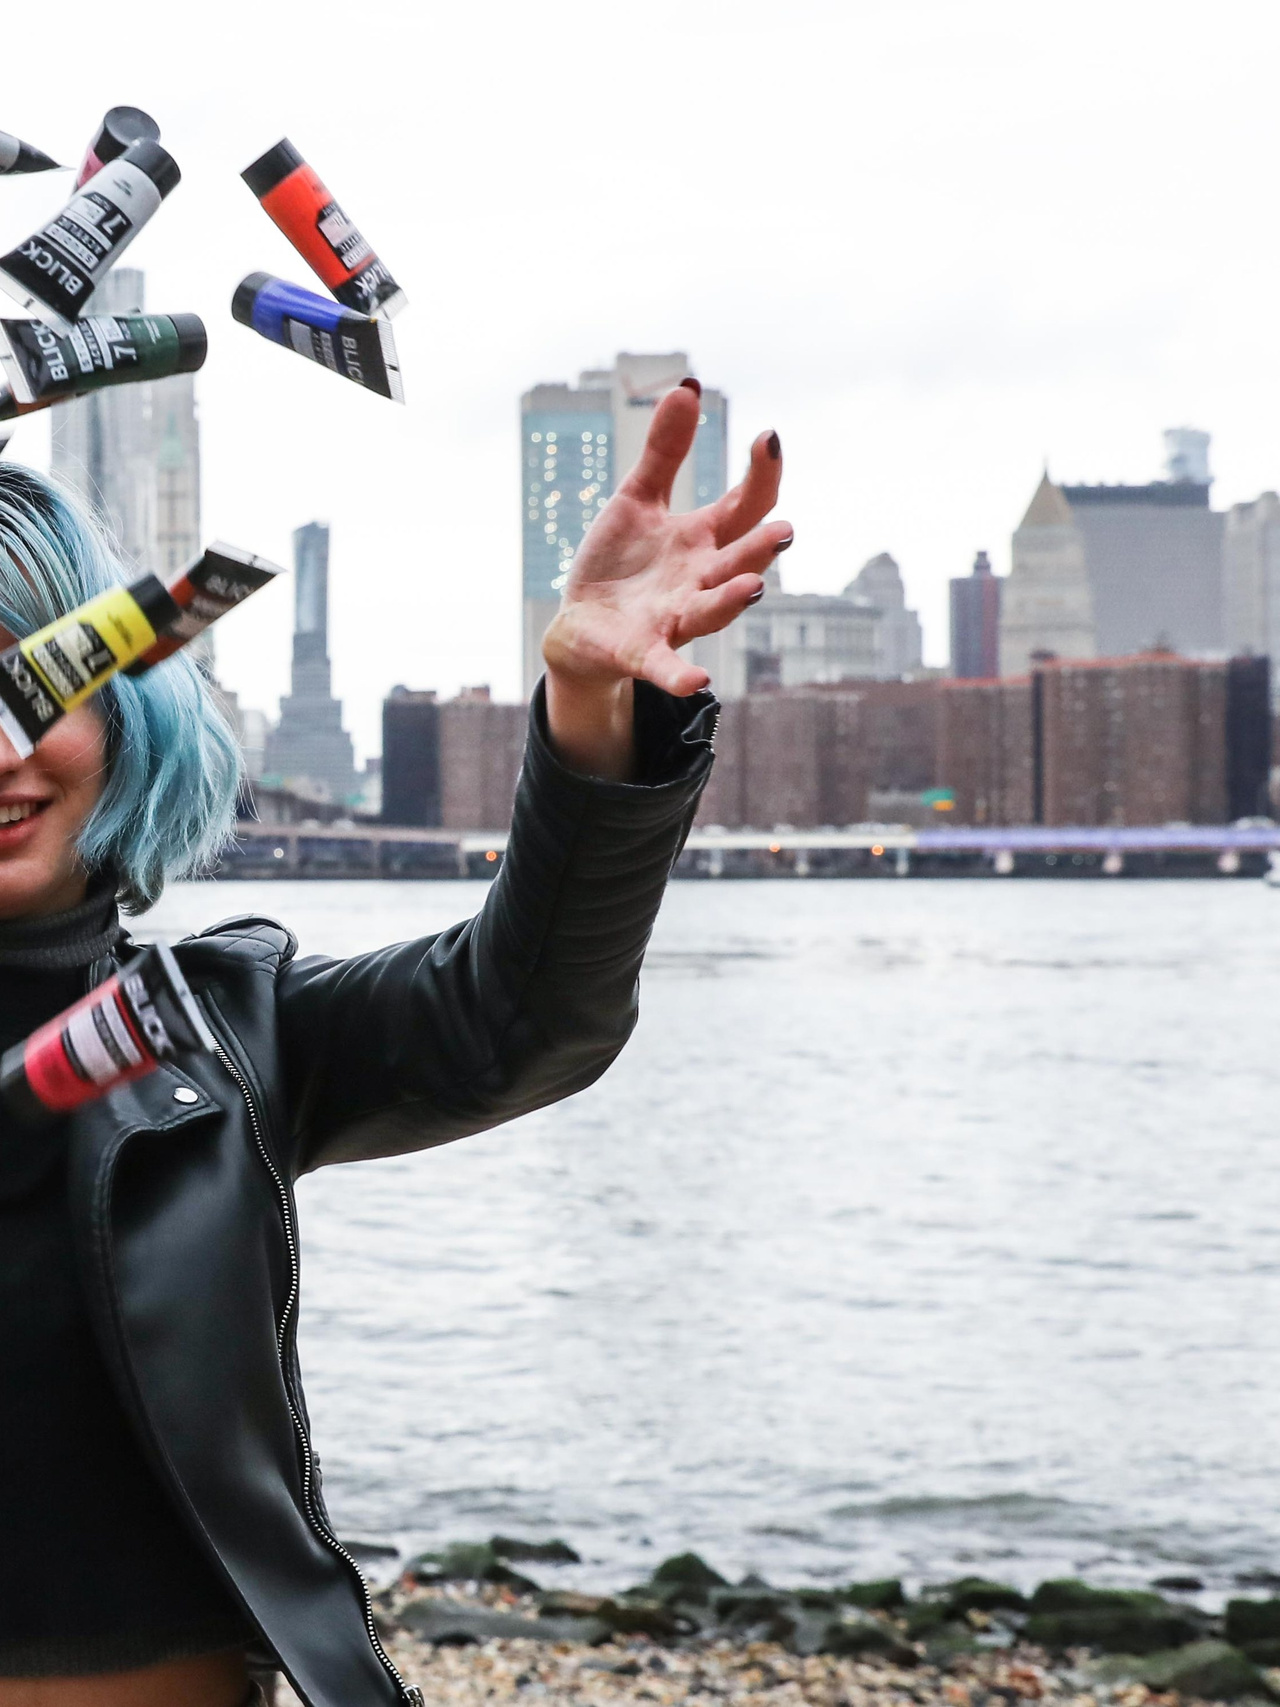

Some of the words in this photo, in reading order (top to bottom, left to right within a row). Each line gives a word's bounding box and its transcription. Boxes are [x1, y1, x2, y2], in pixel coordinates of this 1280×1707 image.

[56, 215, 104, 256] ACRYLIC
[21, 240, 85, 296] BLICK
[29, 319, 69, 380] BLICK
[341, 335, 365, 383] BLIC
